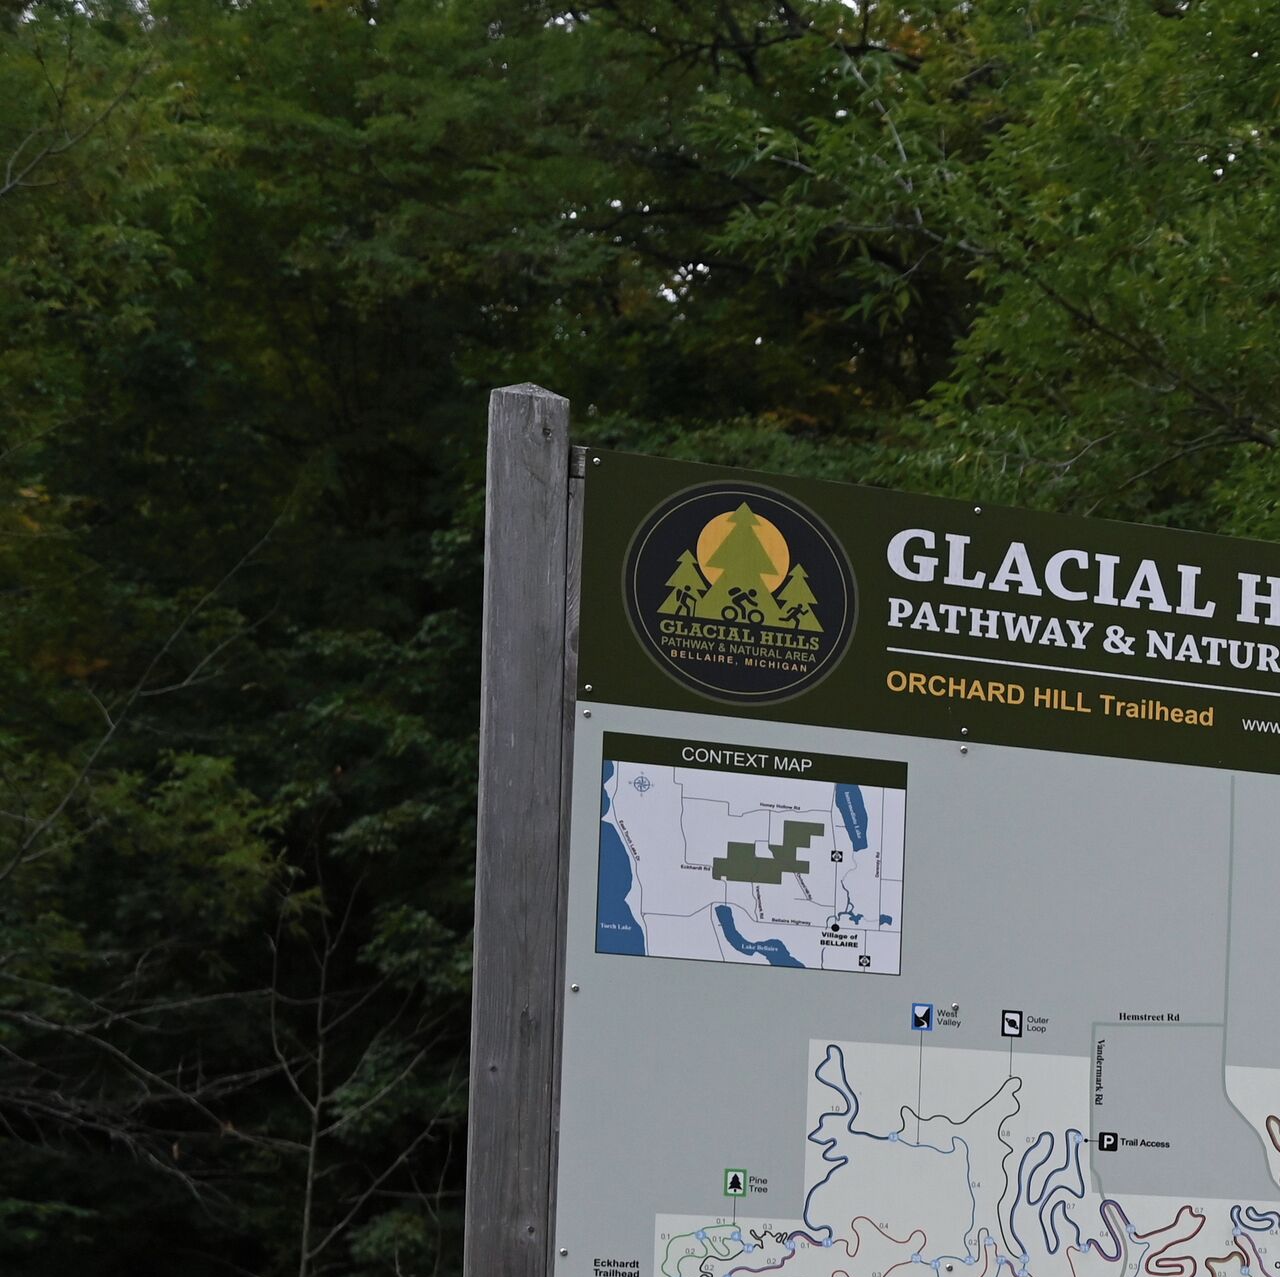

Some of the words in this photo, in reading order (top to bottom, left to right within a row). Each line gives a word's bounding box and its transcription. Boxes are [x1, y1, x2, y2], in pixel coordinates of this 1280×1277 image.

[887, 528, 1217, 619] GLACIAL
[659, 620, 754, 645] GLACIAL
[760, 631, 819, 650] HILLS
[888, 597, 1094, 650] PATHWAY
[1103, 625, 1135, 655] &
[661, 636, 715, 650] PATHWAY
[718, 642, 726, 652] &
[730, 644, 782, 659] NATURAL
[785, 651, 816, 663] AREA
[671, 646, 738, 666] BELLAIRE,
[745, 658, 807, 672] MICHIGAN
[887, 671, 1024, 704] ORCHARD
[1034, 688, 1091, 713] HILL
[1099, 694, 1213, 726] Trailhead
[682, 747, 769, 768] CONTEXT
[774, 756, 812, 772] MAP
[1119, 1012, 1164, 1021] Hemstreet
[1168, 1012, 1181, 1022] Rd
[1120, 1137, 1139, 1147] Trail
[1140, 1138, 1170, 1148] Access
[748, 1185, 768, 1193] Tree
[749, 1176, 768, 1184] Pine
[594, 1258, 639, 1269] Eckhardt
[594, 1269, 639, 1277] Trailhead
